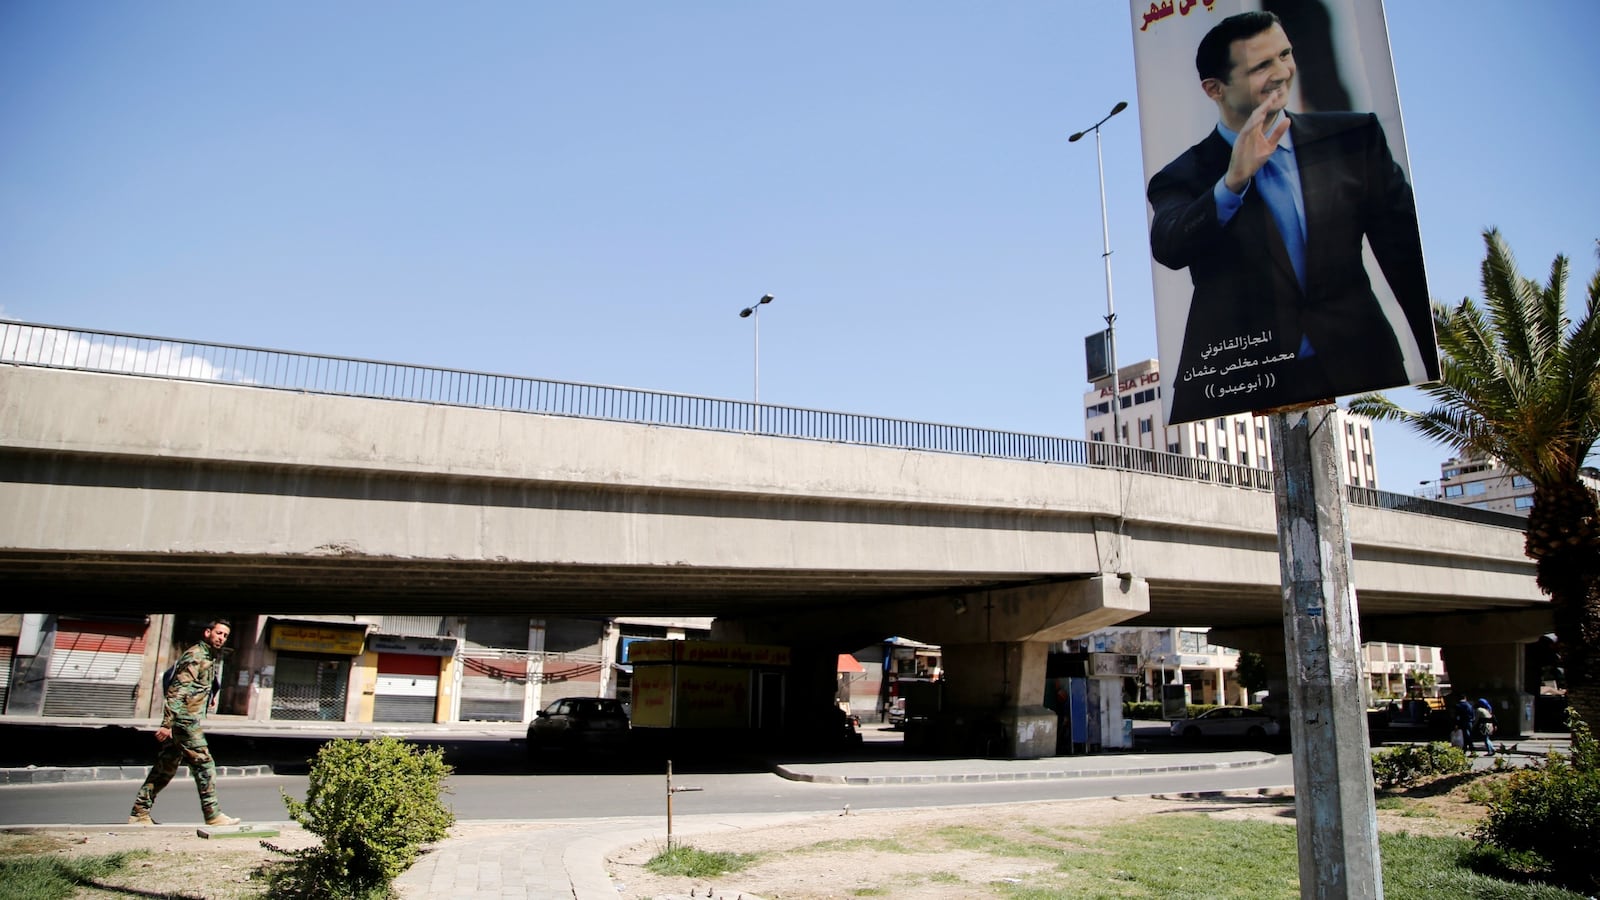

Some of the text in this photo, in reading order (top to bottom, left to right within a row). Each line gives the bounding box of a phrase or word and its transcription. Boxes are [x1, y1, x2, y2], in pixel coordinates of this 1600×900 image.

[1183, 351, 1296, 382] محمد مخلص عثمان
